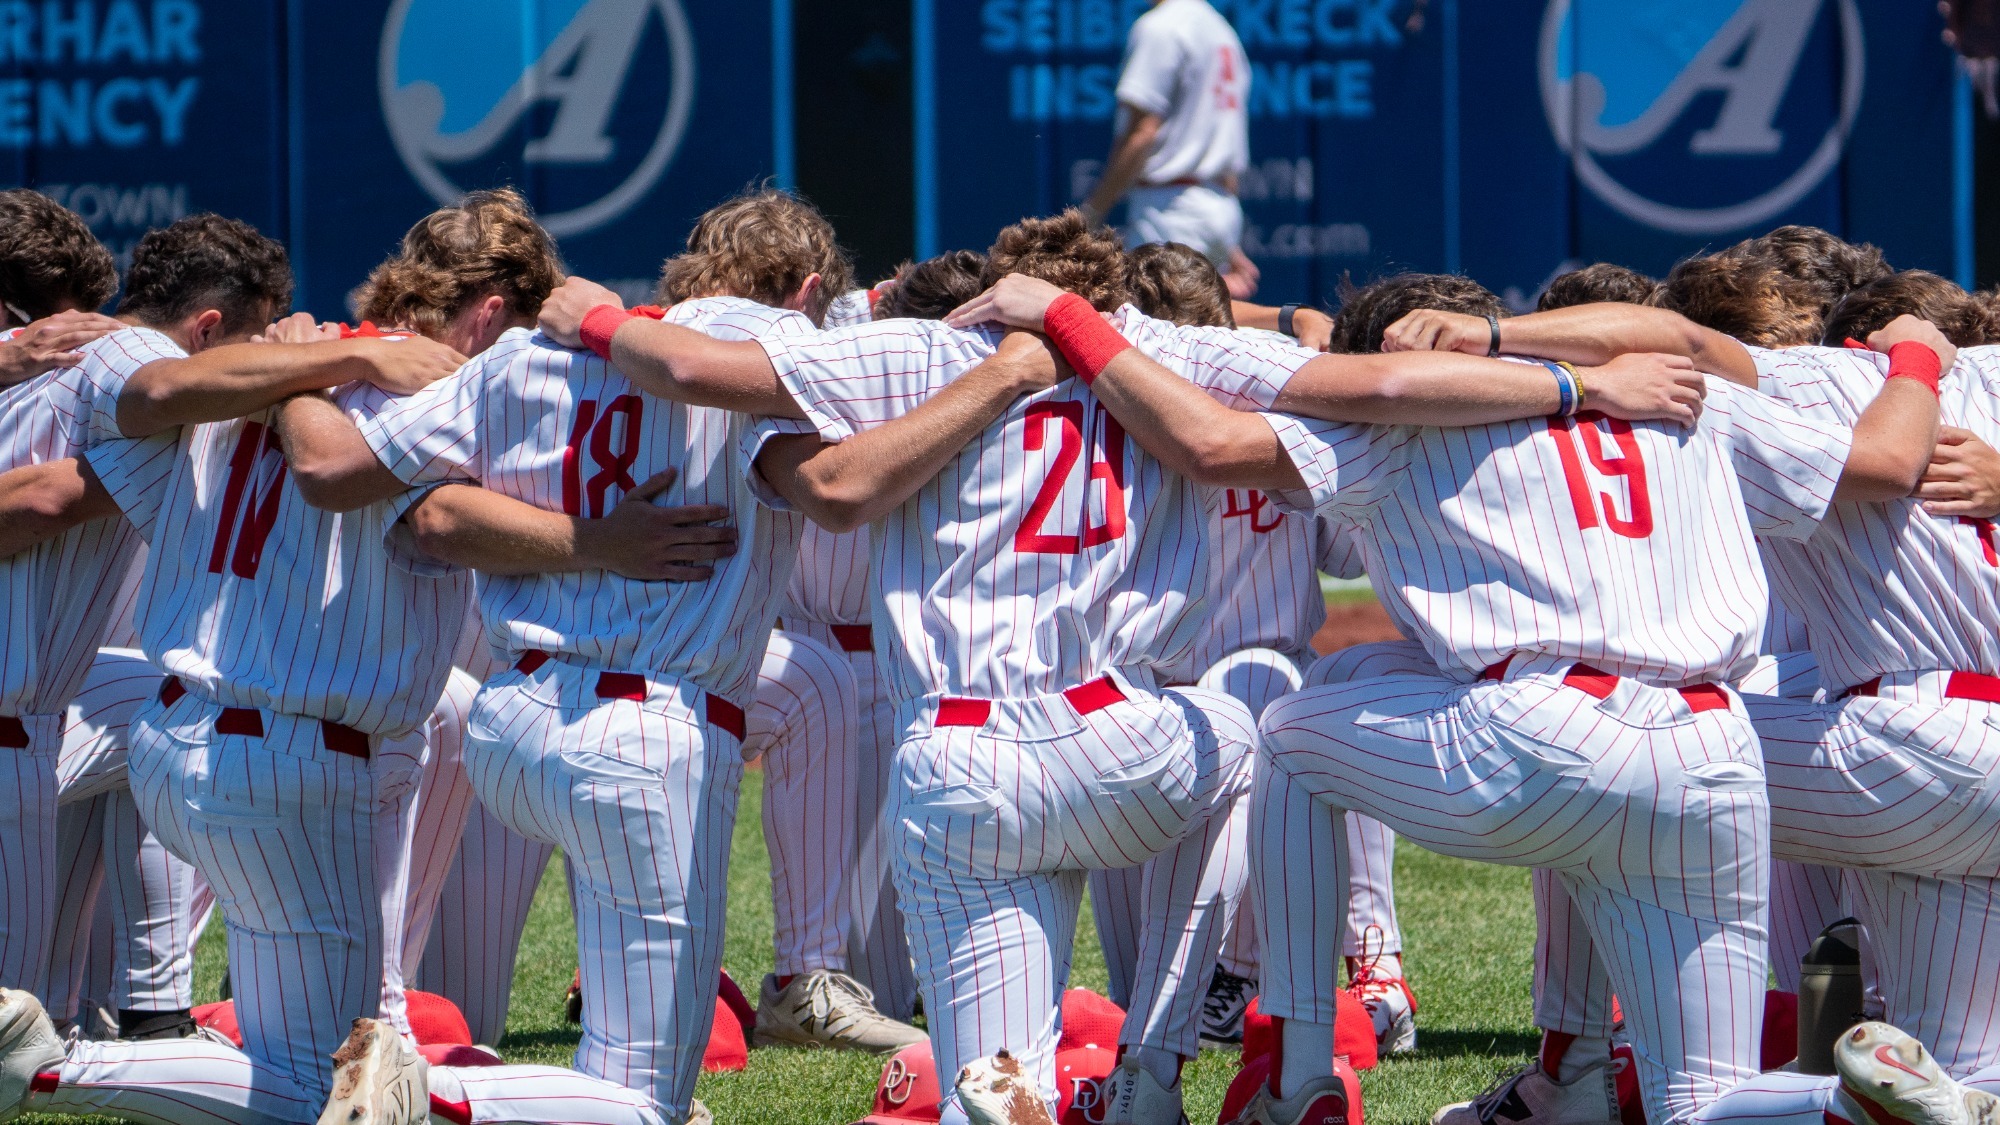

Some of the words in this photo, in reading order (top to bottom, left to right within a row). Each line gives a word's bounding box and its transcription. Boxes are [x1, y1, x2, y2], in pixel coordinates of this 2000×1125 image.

[983, 0, 1402, 49] SEIBKECK
[1009, 61, 1374, 118] INSNCE
[562, 394, 644, 519] 18
[1547, 410, 1654, 538] 19
[885, 1058, 918, 1104] DU
